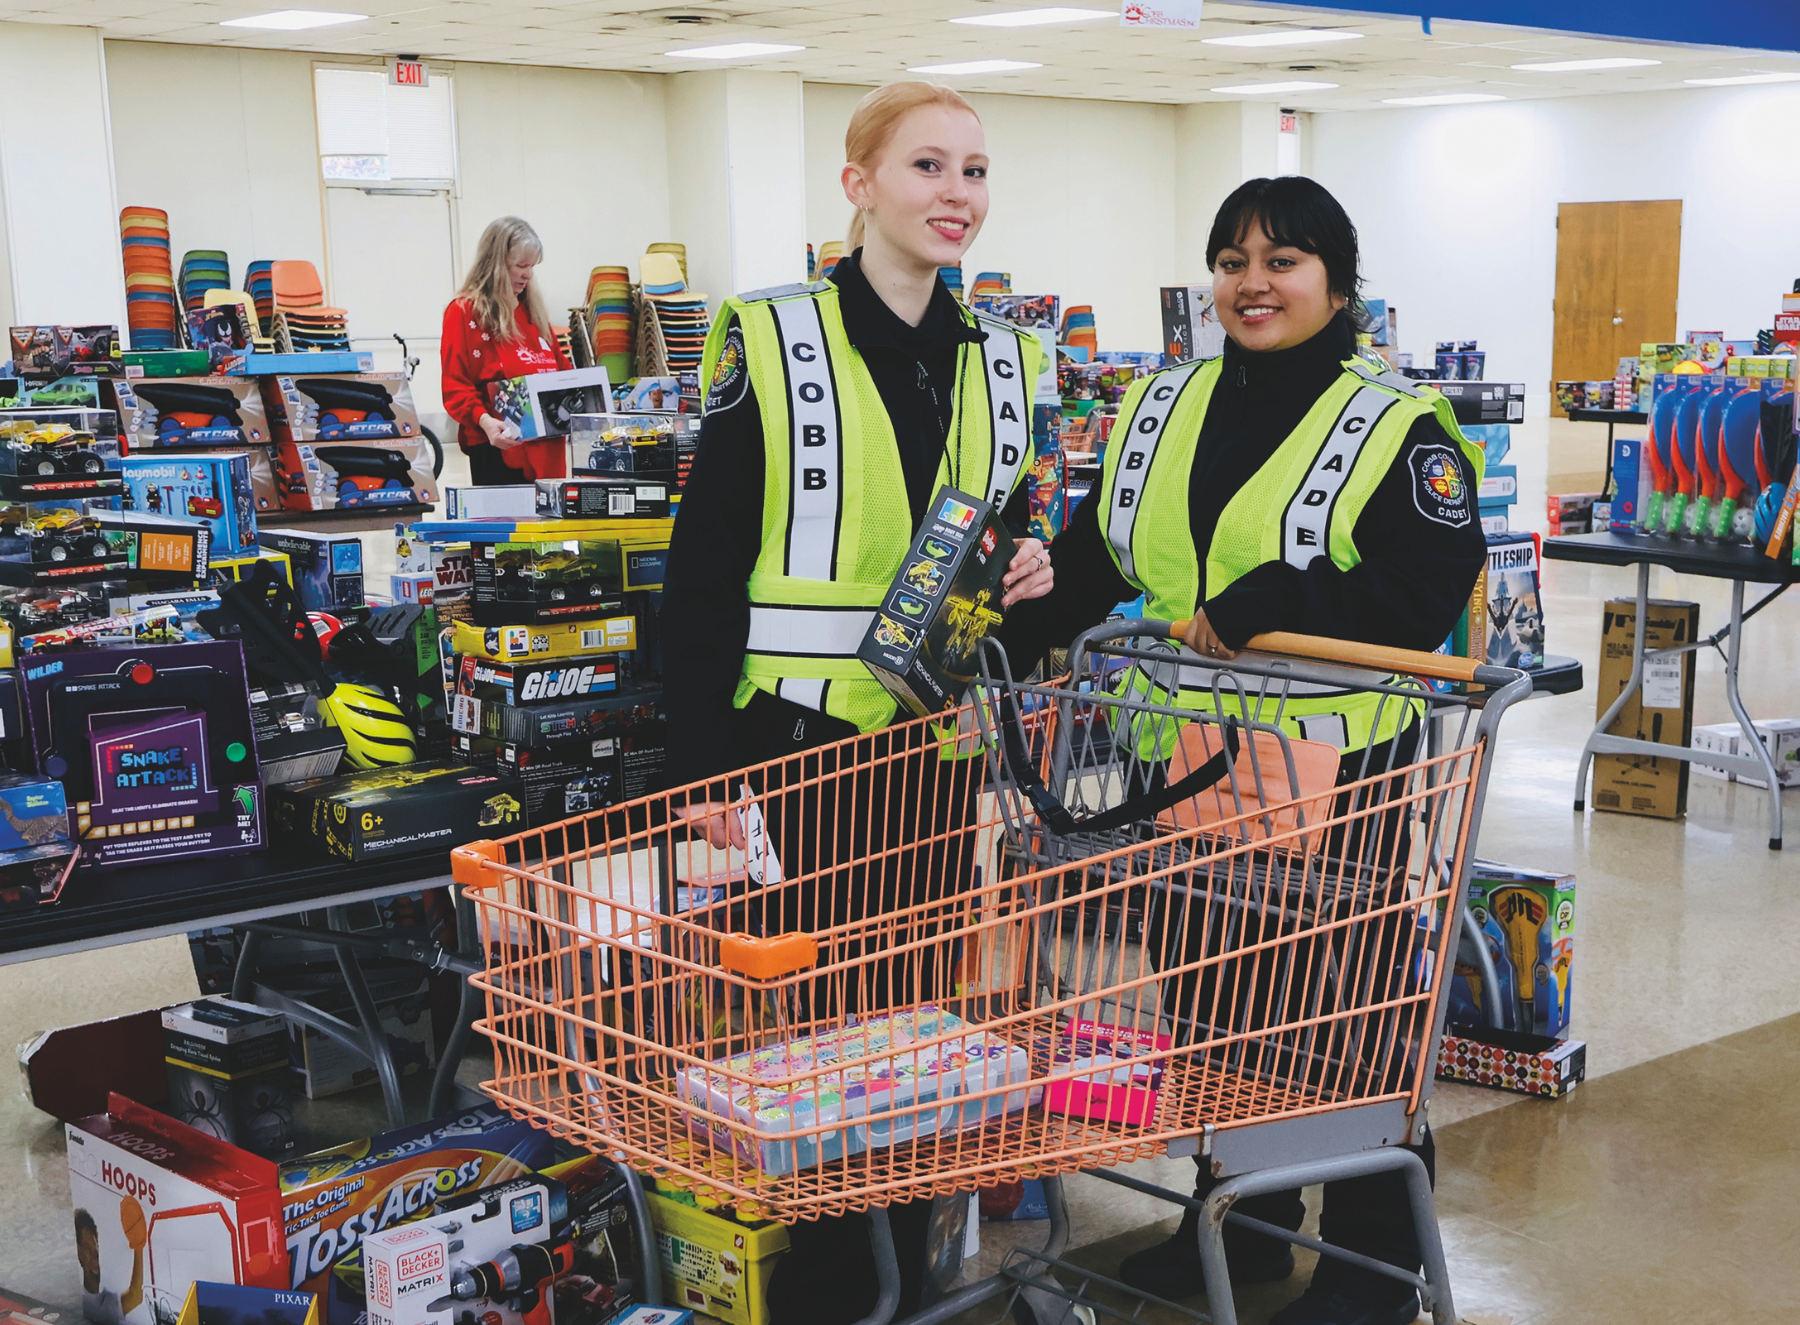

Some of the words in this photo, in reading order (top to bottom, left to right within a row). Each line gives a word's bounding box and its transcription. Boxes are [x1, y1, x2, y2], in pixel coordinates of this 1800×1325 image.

[396, 62, 423, 84] EXIT
[345, 424, 367, 432] JET
[367, 424, 393, 434] CAR
[992, 358, 1019, 510] CADE
[1422, 453, 1438, 472] COBB
[122, 466, 176, 481] laymobil
[1296, 416, 1366, 546] CADE
[364, 491, 386, 500] JET
[386, 491, 412, 500] CAR
[1423, 480, 1442, 502] POLICE
[1438, 506, 1467, 519] CADET
[436, 555, 472, 572] STA
[1488, 547, 1533, 571] TLESHIP
[420, 587, 434, 598] LEG
[27, 660, 64, 681] WILDER
[541, 717, 576, 733] STEM
[121, 748, 181, 767] SNAKE
[116, 768, 189, 788] ATTACK
[361, 812, 383, 831] 6+
[364, 835, 418, 849] MECHANICAL
[418, 828, 452, 840] MASTER
[108, 1131, 175, 1160] HOOPS
[102, 1159, 156, 1206] HOOPS
[283, 1199, 313, 1222] The
[316, 1176, 365, 1208] Original
[401, 1250, 439, 1267] BLACK+
[402, 1258, 440, 1275] DECKER
[397, 1274, 443, 1295] MATRIX
[274, 1293, 310, 1306] PIXAR
